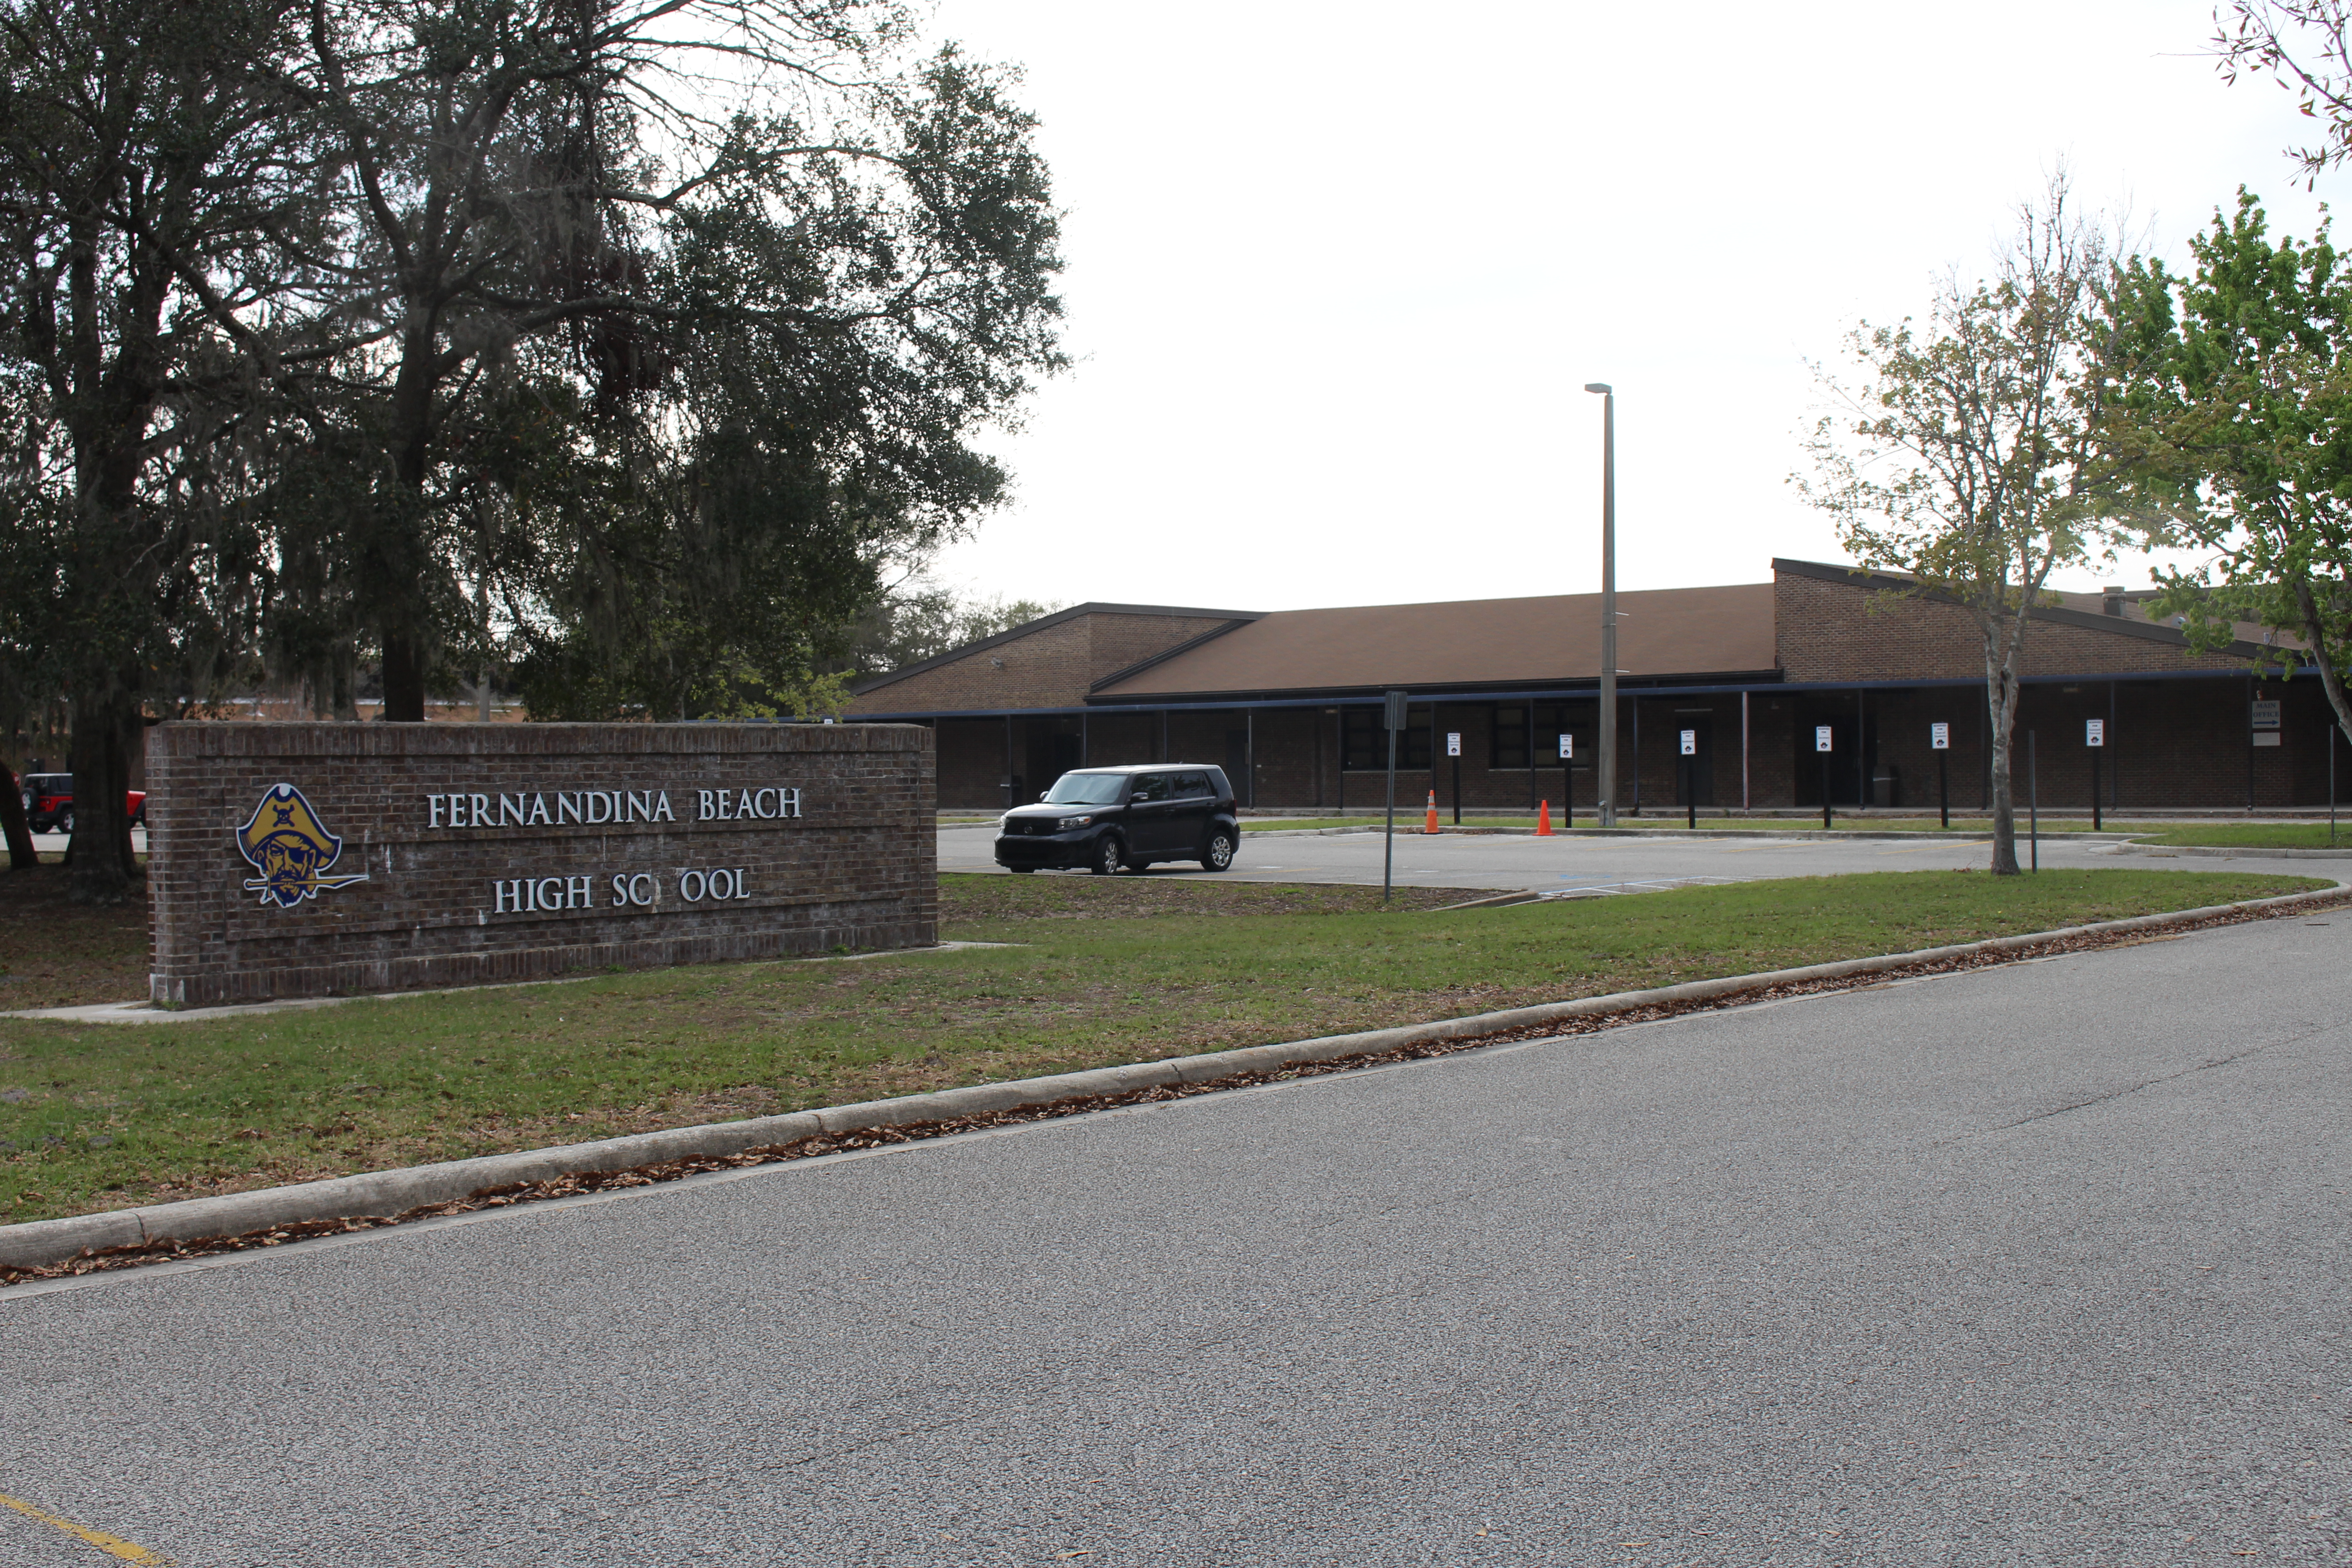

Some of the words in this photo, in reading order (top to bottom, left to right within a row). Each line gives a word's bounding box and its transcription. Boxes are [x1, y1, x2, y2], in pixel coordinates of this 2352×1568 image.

[426, 790, 676, 828] FERNANDINA
[697, 788, 802, 821] BEACH
[494, 876, 593, 913] HIGH
[612, 869, 750, 906] SCOOL
